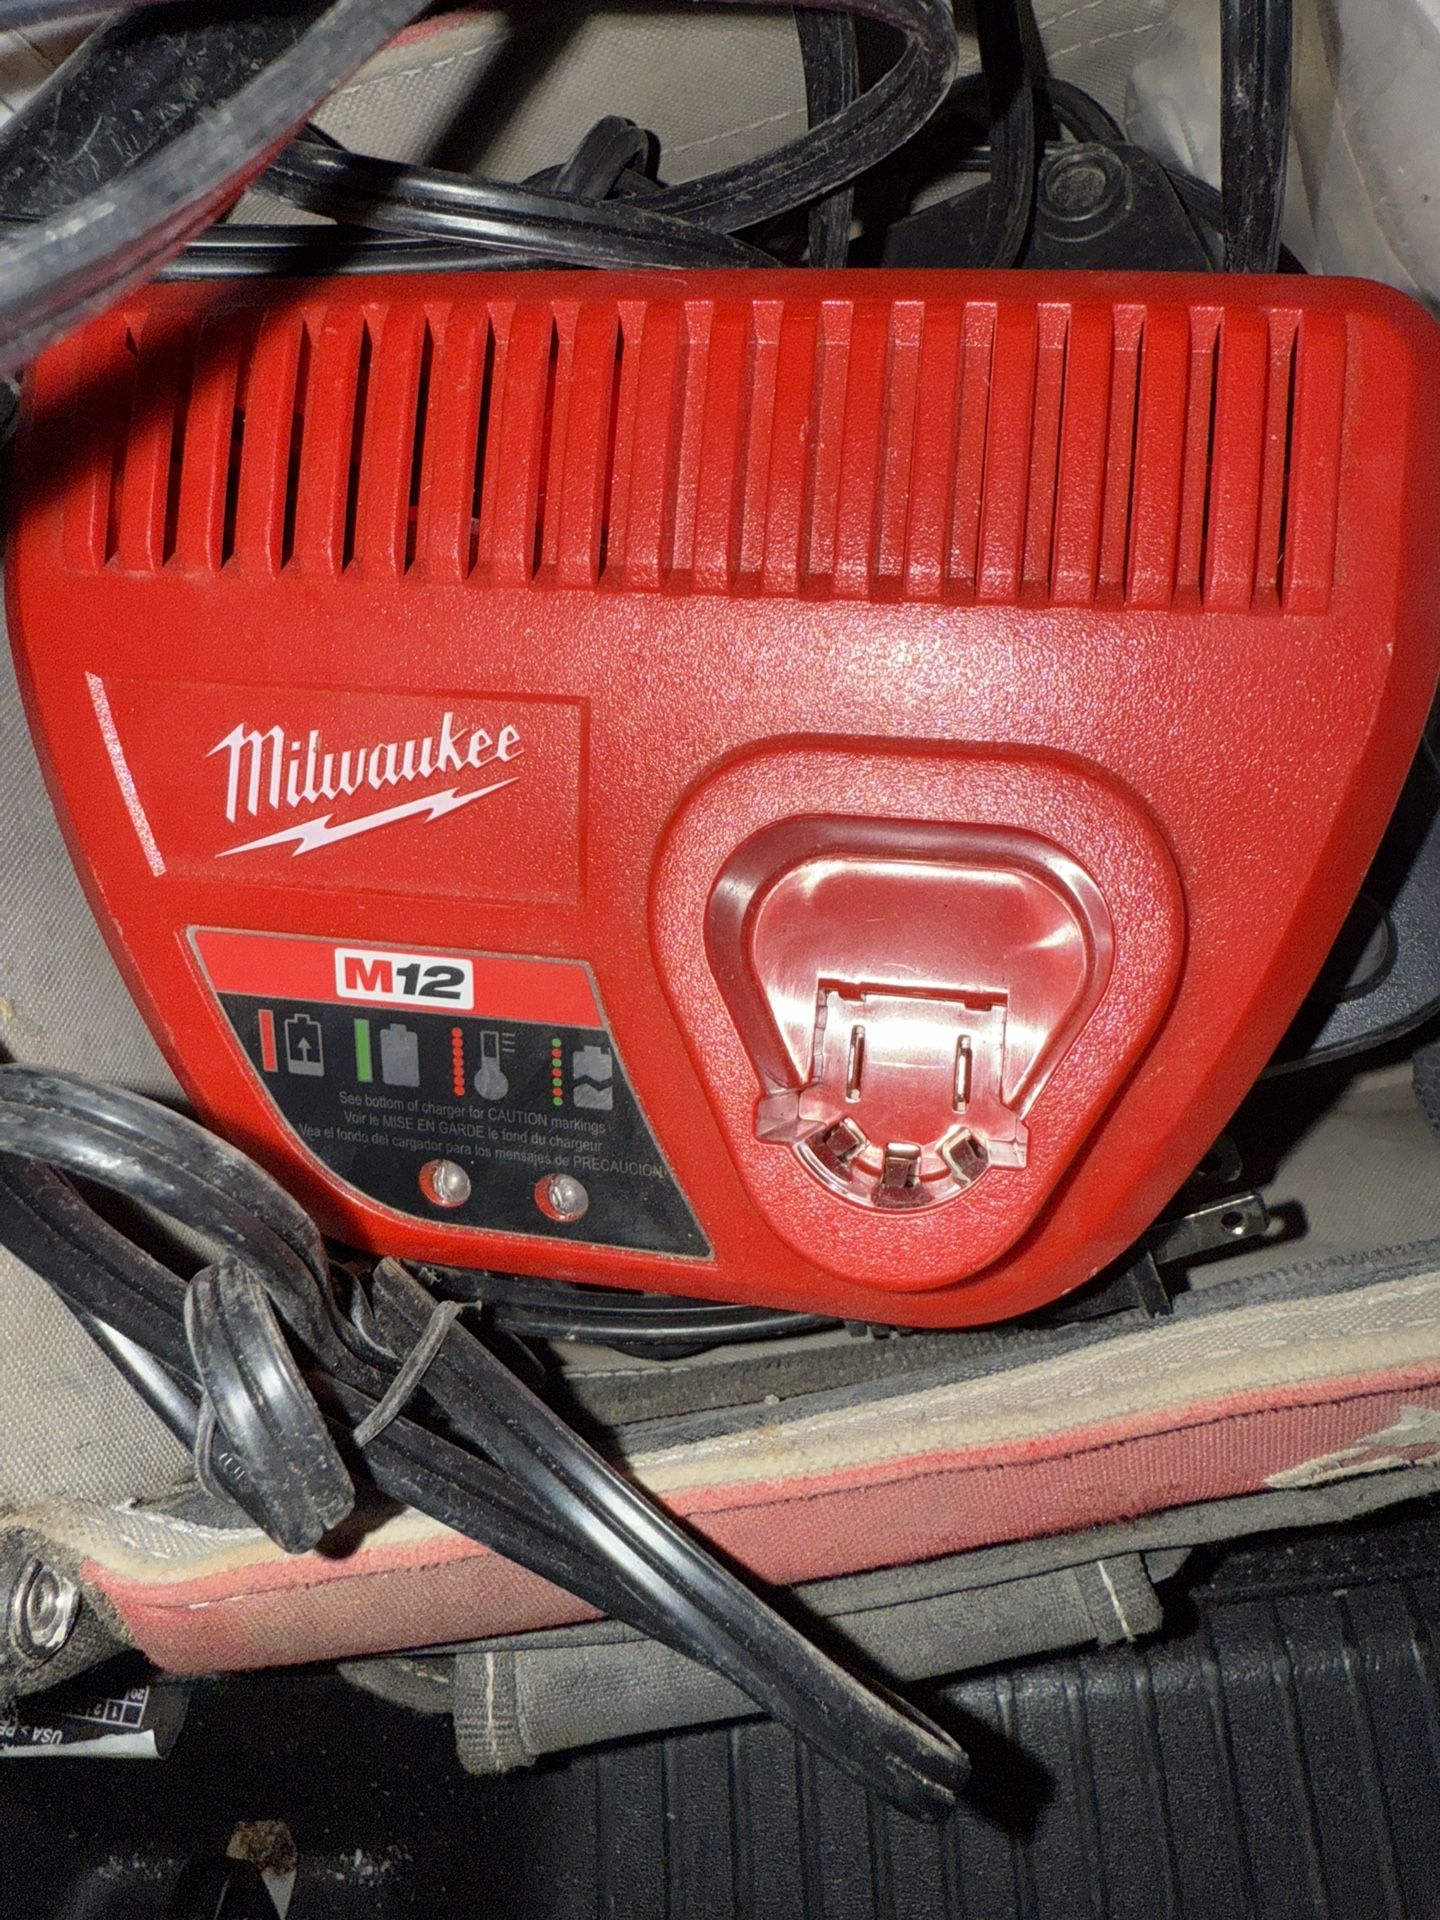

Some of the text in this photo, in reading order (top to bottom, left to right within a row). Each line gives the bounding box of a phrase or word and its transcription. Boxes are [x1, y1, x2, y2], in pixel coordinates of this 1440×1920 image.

[206, 712, 526, 824] Milwaukee
[344, 957, 466, 1000] M12
[339, 1090, 606, 1136] See bottom of charger for CAUTION markings
[343, 1110, 603, 1153] Voir le MISE EN GARDE le fond du chargeur
[299, 1122, 321, 1138] Vea
[323, 1126, 335, 1139] el
[336, 1127, 369, 1143] fondo
[371, 1132, 389, 1146] del
[391, 1136, 443, 1152] cargador
[446, 1143, 472, 1155] para
[474, 1144, 492, 1158] los
[495, 1149, 552, 1167] mensajes
[554, 1154, 570, 1168] de
[32, 1727, 63, 1744] USA
